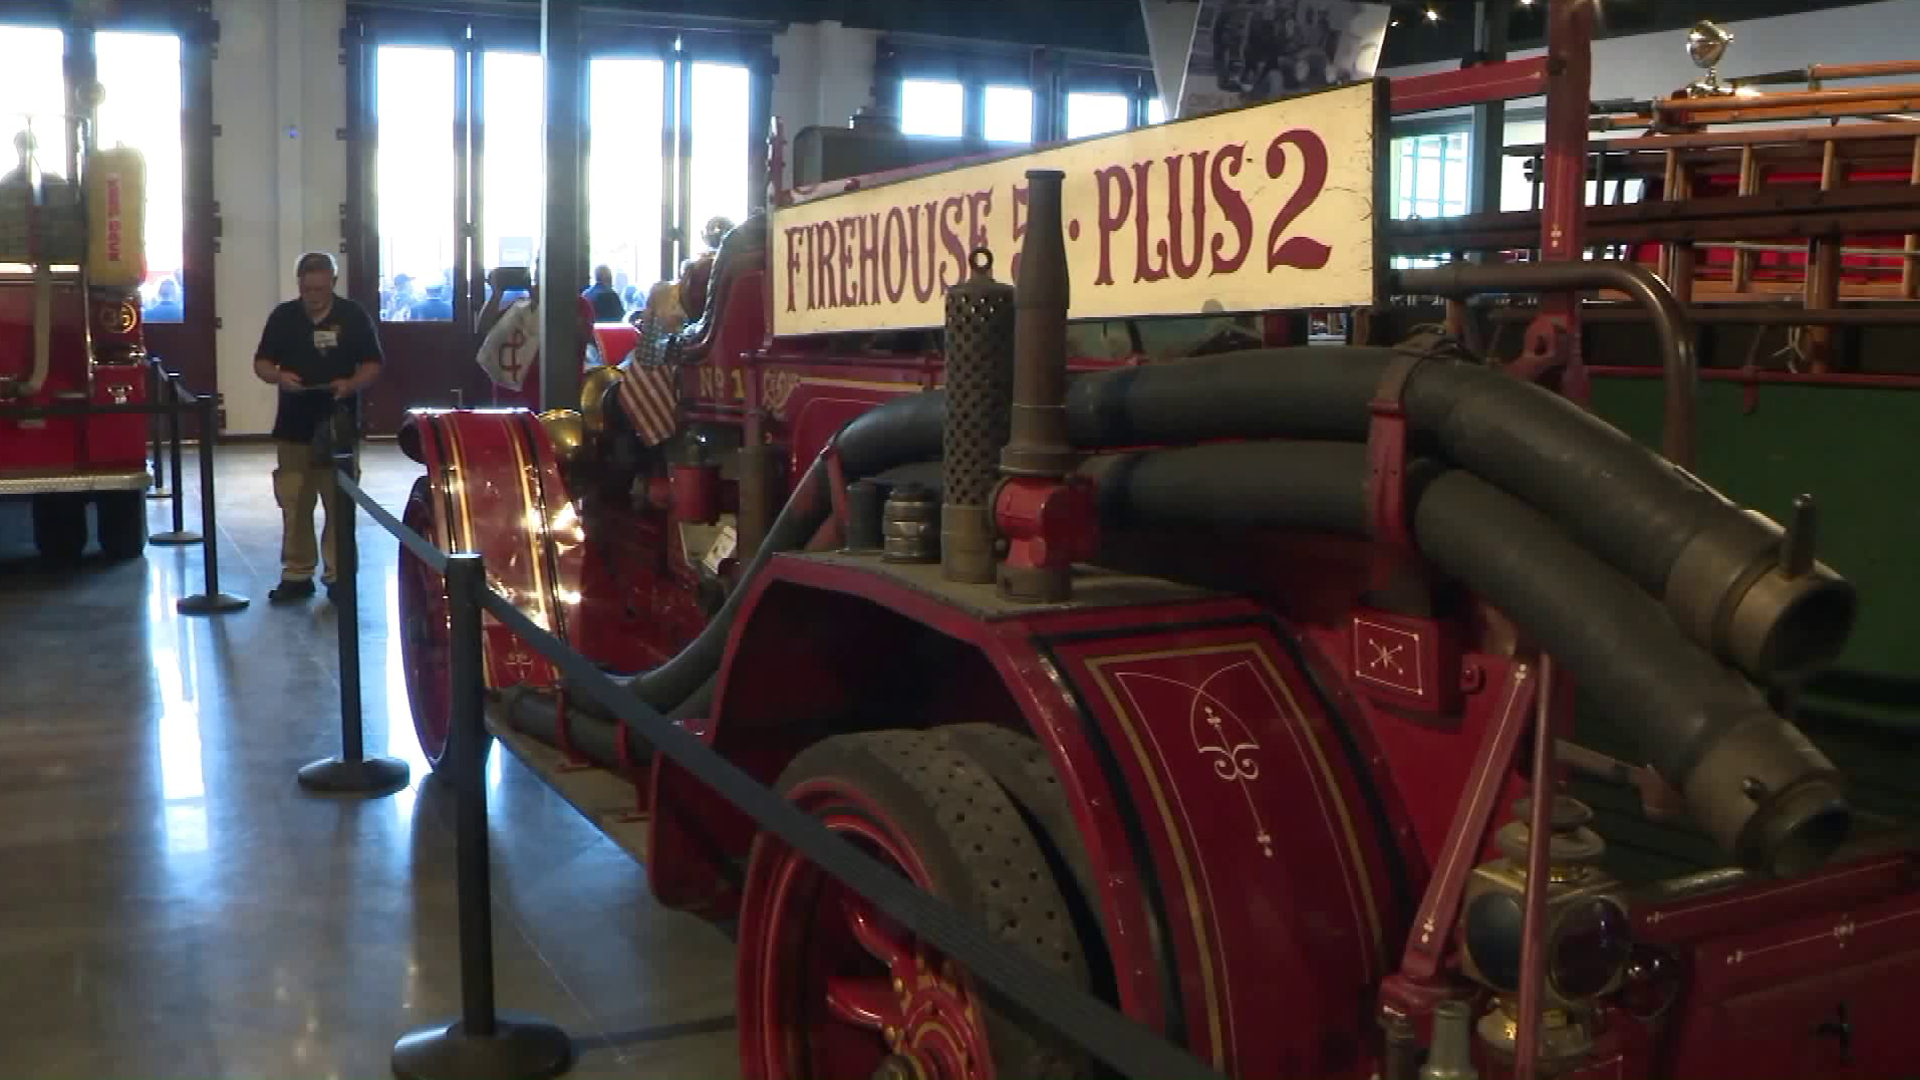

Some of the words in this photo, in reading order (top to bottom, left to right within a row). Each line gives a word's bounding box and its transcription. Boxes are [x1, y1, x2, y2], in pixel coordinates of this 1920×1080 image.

[785, 184, 994, 312] FIREHOUSE
[1094, 141, 1253, 285] PLUS
[1266, 129, 1333, 273] 2
